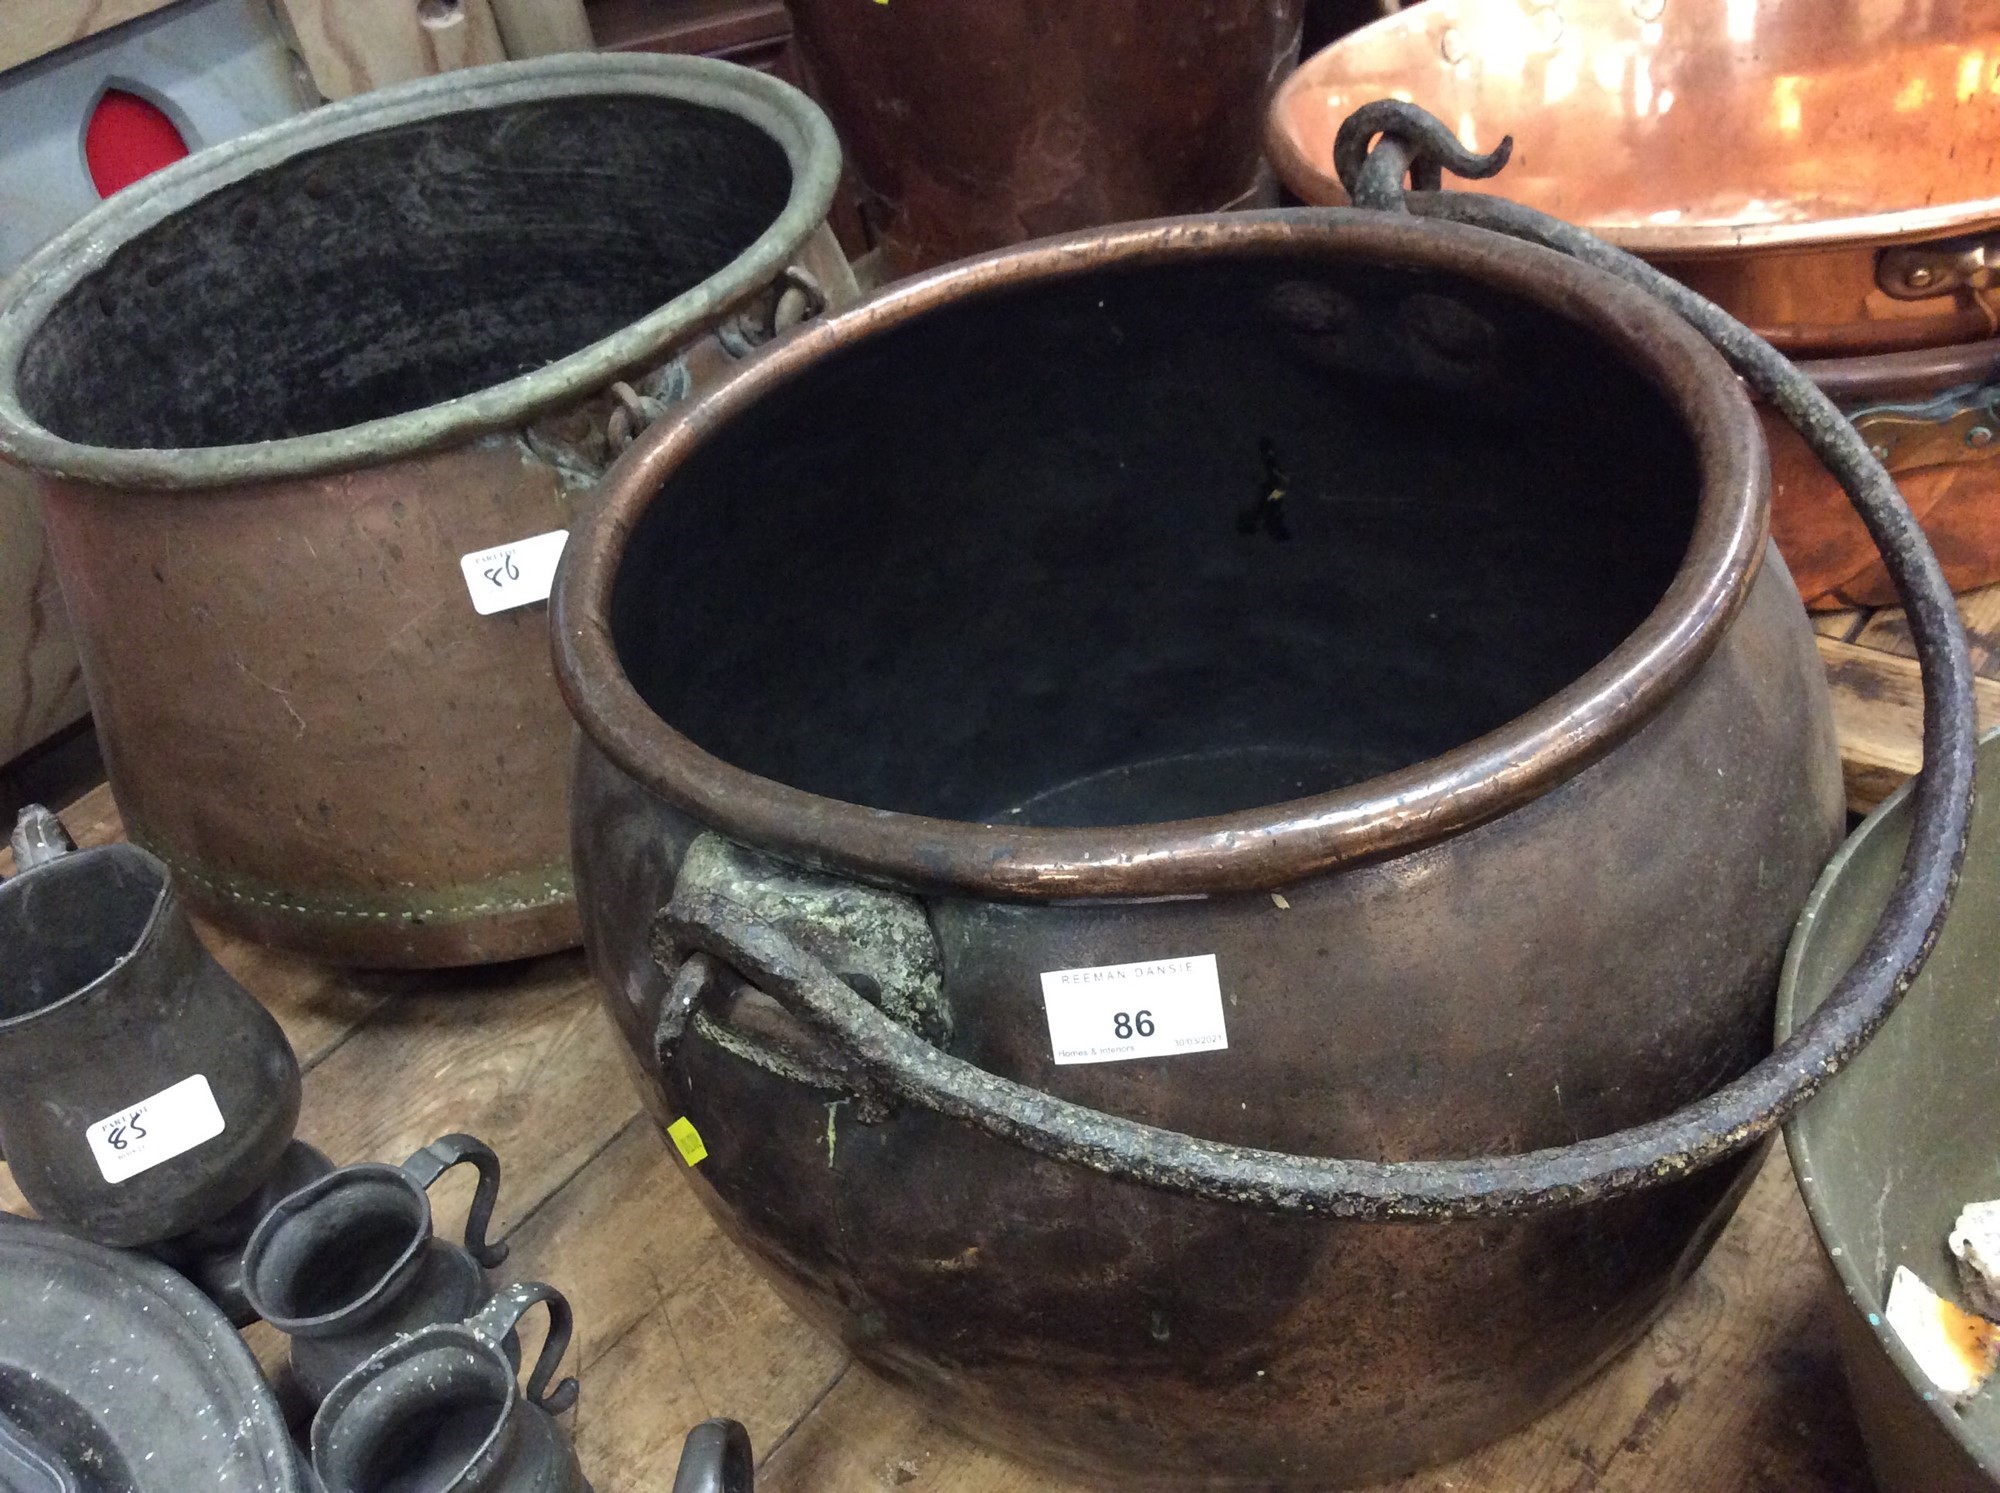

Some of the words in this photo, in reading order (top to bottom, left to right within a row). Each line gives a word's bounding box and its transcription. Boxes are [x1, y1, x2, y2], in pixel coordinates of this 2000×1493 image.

[484, 554, 520, 587] 86
[1061, 970, 1126, 984] REEMAN
[1134, 961, 1193, 978] DANSIE
[1113, 1009, 1155, 1039] 86
[1058, 1049, 1088, 1058] Homes
[1090, 1047, 1098, 1056] &
[108, 1112, 147, 1150] 85
